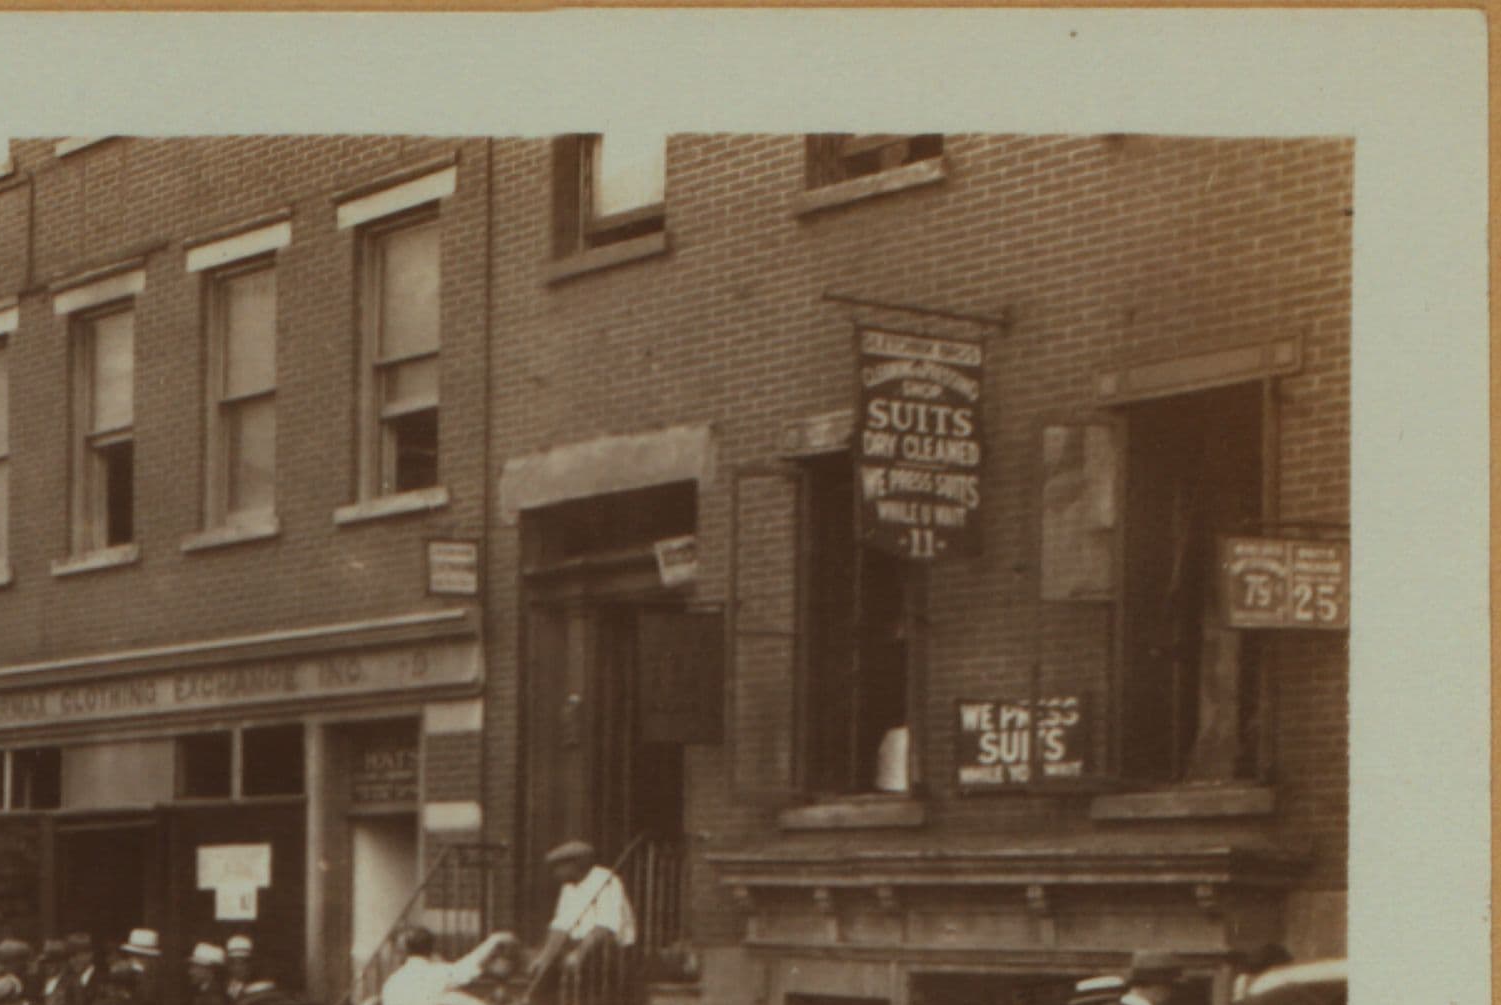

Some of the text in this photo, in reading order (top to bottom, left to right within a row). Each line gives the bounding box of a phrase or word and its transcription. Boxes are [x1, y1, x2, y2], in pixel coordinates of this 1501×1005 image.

[866, 398, 973, 437] SUITS
[862, 431, 980, 467] DRY CLEANED
[861, 466, 980, 510] WE PRESS SUITS
[173, 660, 300, 701] EXCHANGE
[961, 702, 995, 732] WE
